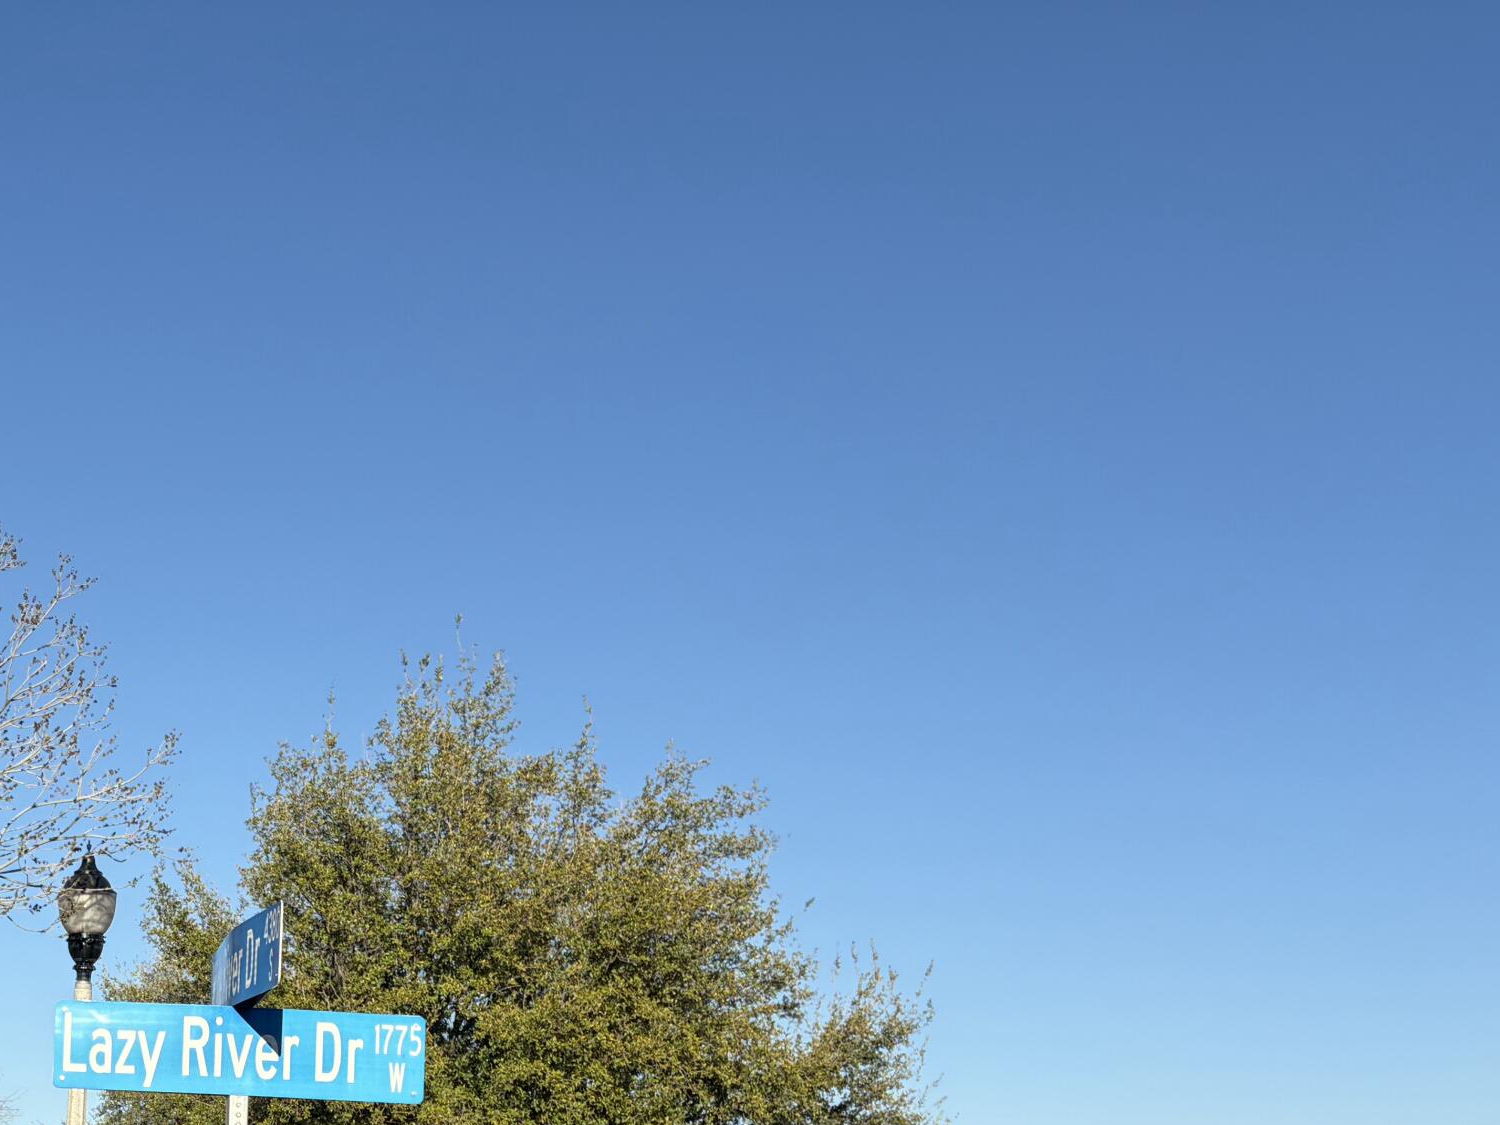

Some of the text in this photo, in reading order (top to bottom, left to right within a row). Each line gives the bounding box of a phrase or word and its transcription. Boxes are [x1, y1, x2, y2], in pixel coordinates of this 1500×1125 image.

[245, 928, 260, 989] Dr
[268, 947, 274, 982] S
[63, 1011, 364, 1088] Lazy River Dr
[374, 1023, 422, 1056] 1775
[388, 1062, 406, 1093] W
